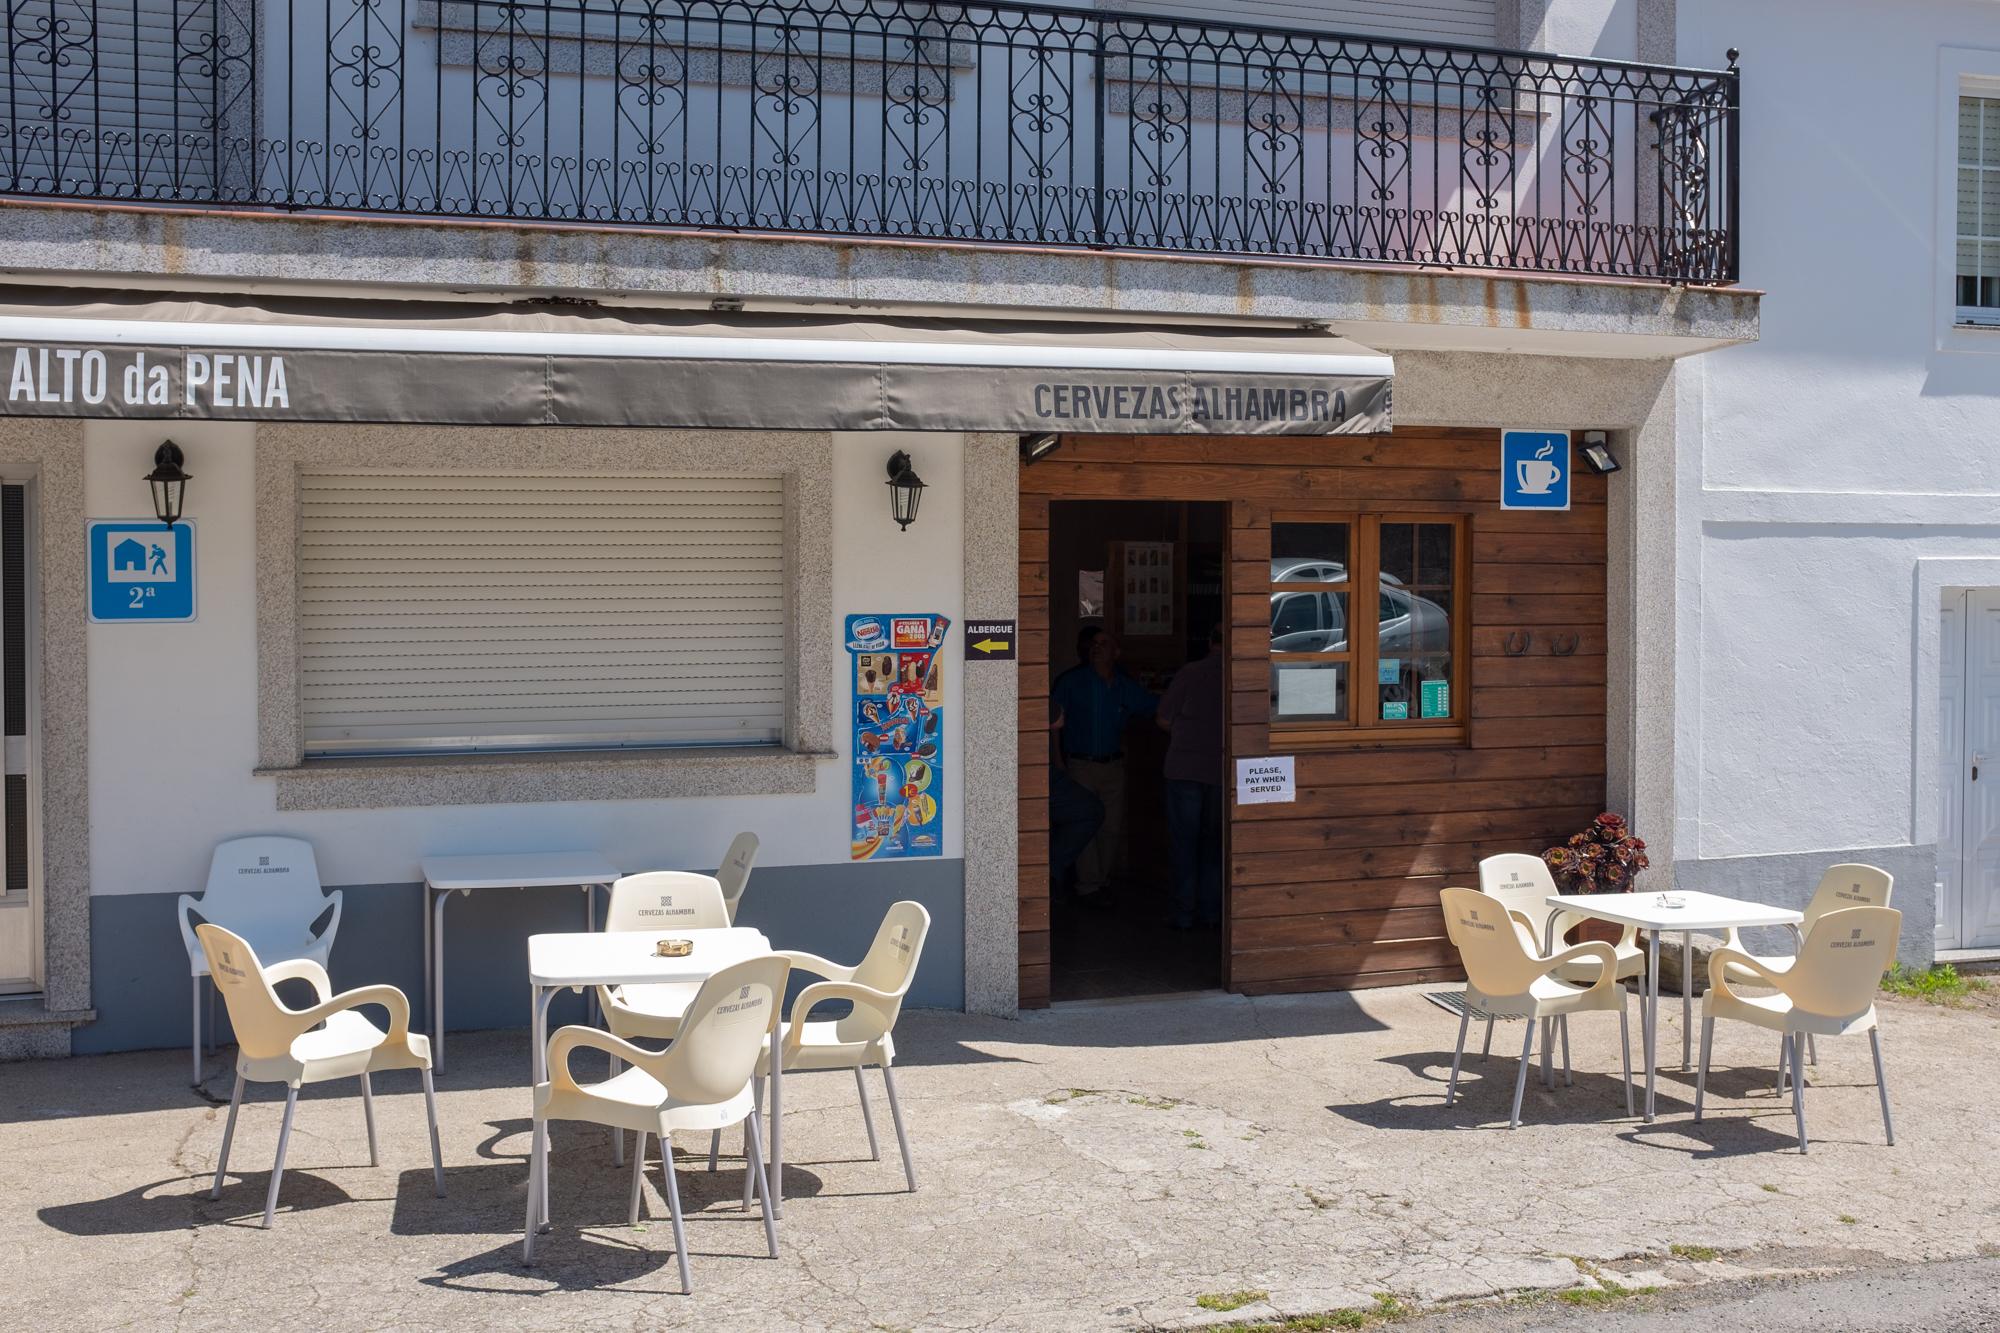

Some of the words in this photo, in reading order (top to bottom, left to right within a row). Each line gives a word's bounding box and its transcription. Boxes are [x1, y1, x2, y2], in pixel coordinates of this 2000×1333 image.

[9, 347, 107, 405] ALTO
[123, 352, 169, 405] da
[186, 353, 290, 409] PENA
[1034, 383, 1181, 420] CERVEZAS
[1192, 386, 1346, 422] ALHAMBRA
[896, 625, 925, 634] GANA
[968, 625, 1013, 634] ALBERGUE
[1249, 767, 1282, 775] PLEASE,
[1245, 777, 1260, 785] PAY
[1262, 775, 1286, 783] WHEN
[1250, 785, 1282, 793] SERVED
[638, 909, 665, 917] CERVEZAS
[666, 908, 696, 916] ALHAMBRA
